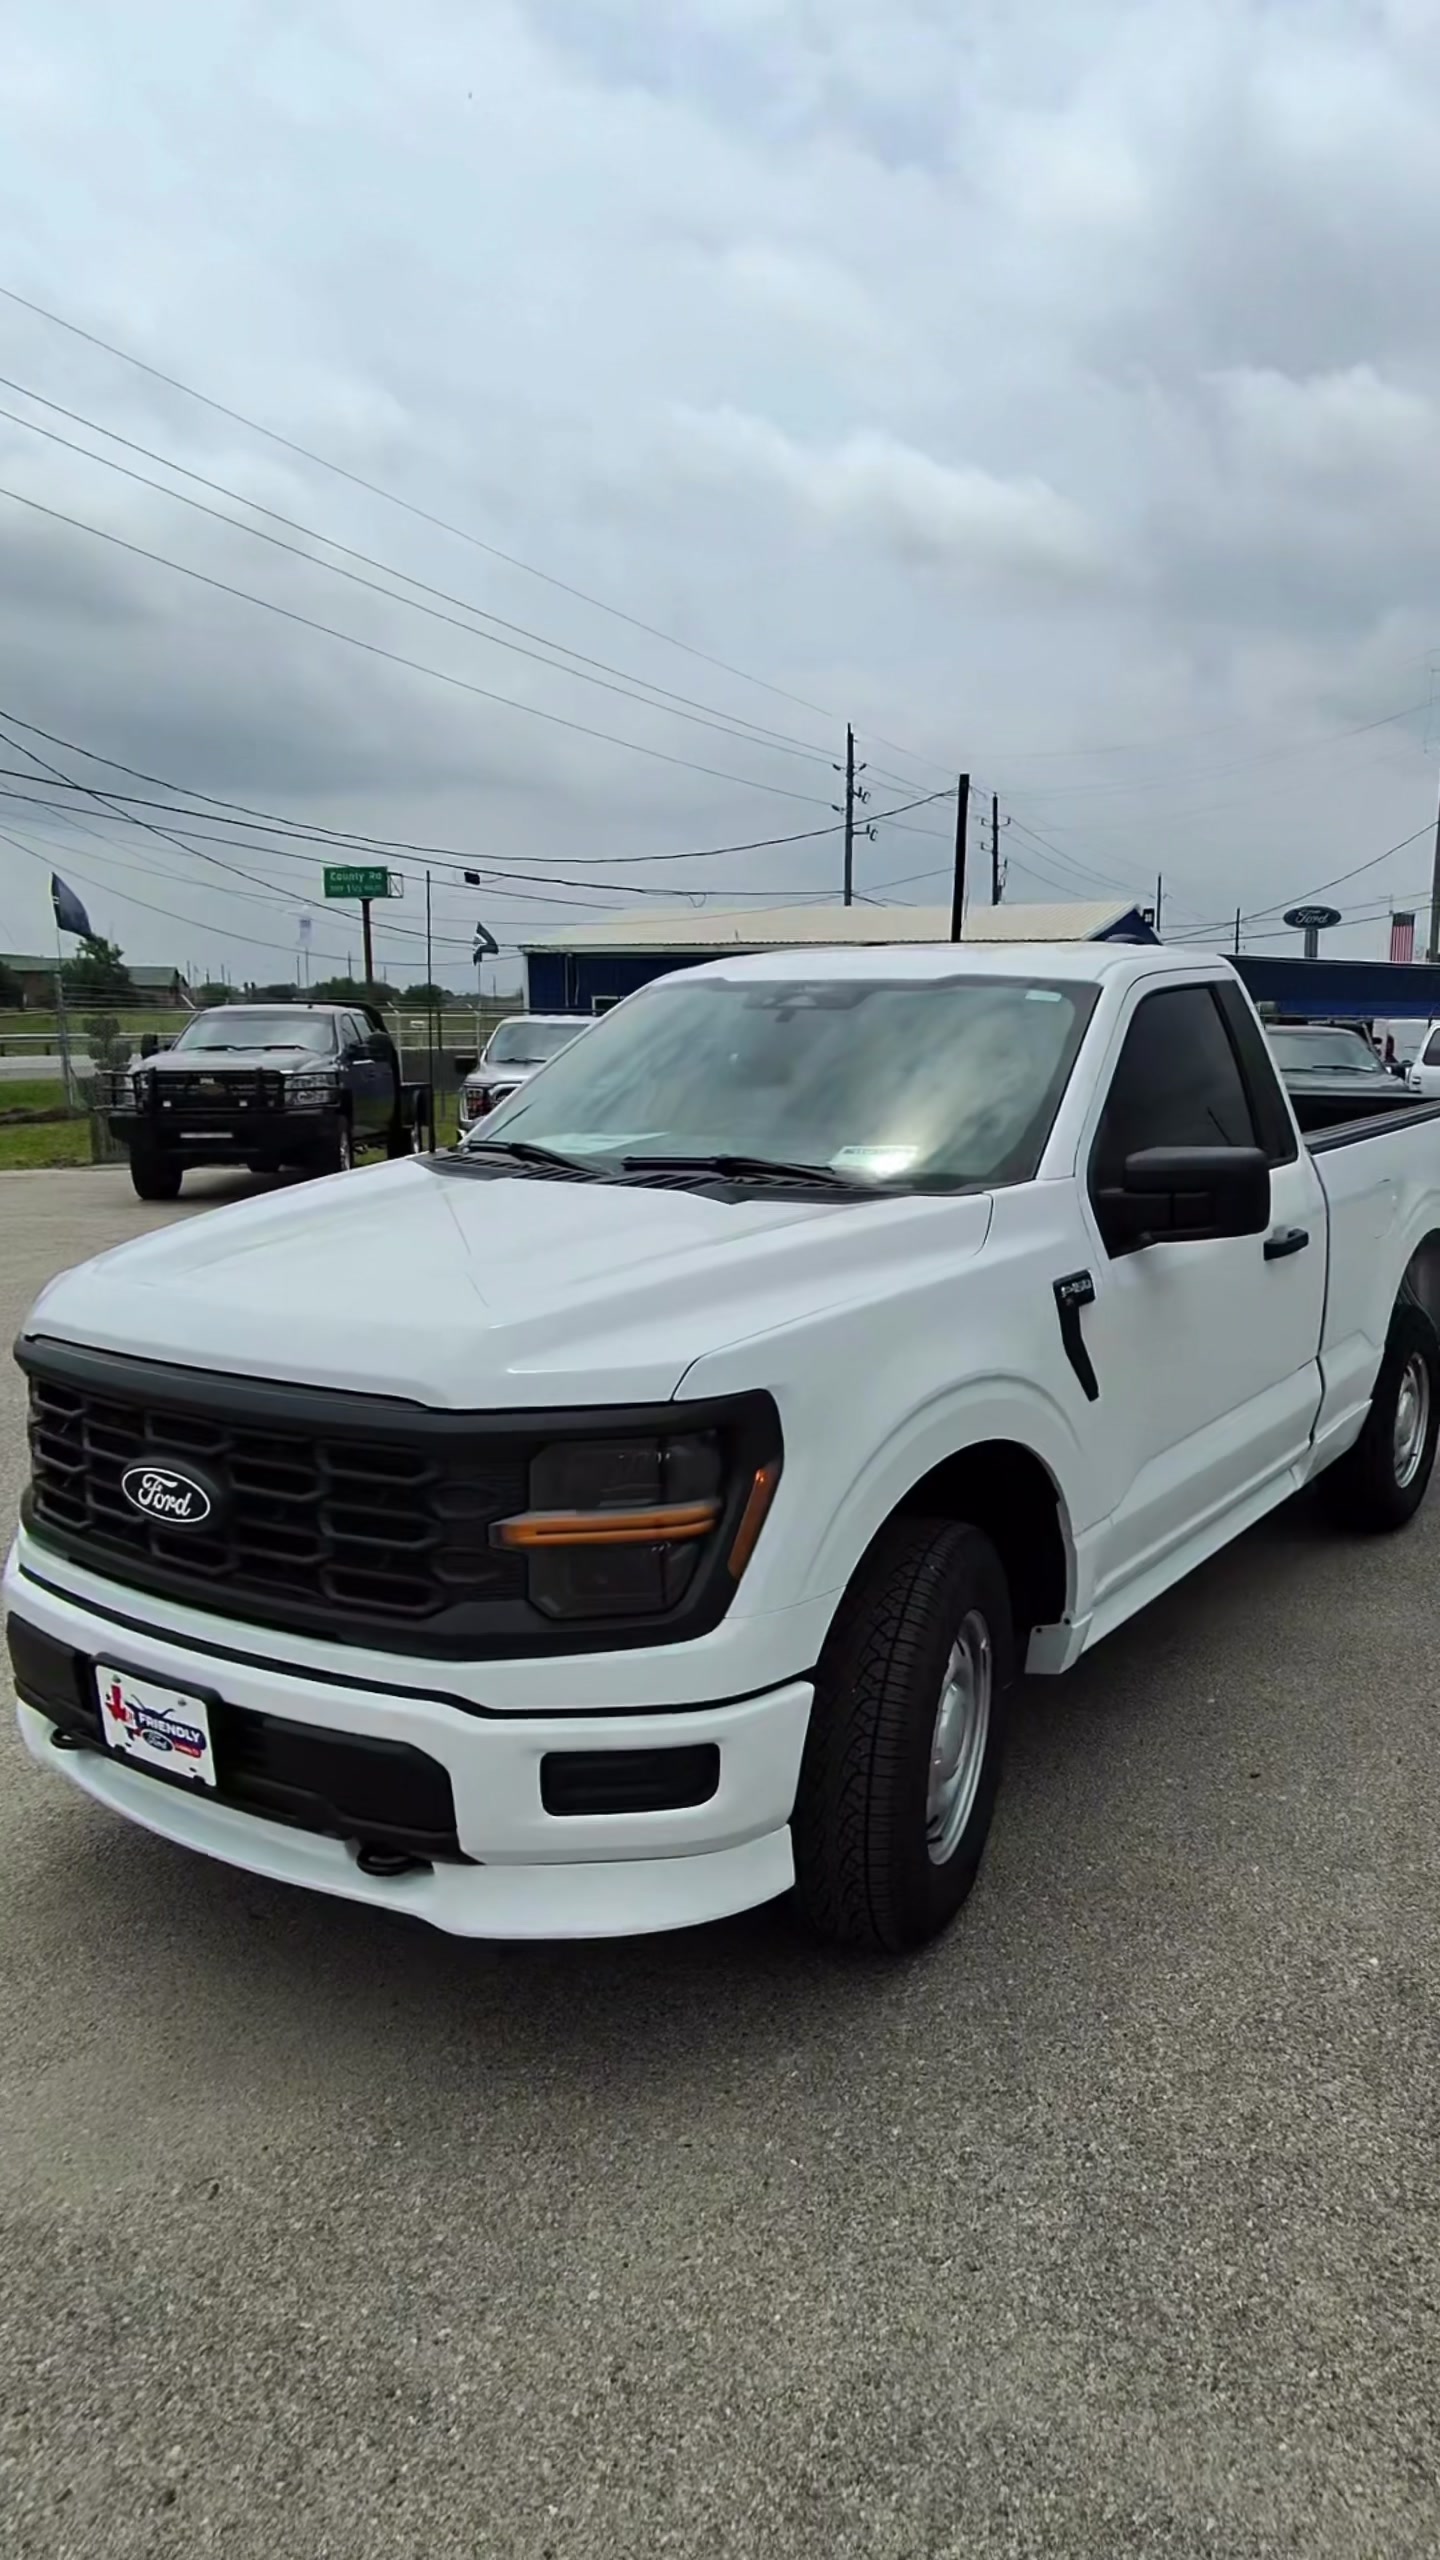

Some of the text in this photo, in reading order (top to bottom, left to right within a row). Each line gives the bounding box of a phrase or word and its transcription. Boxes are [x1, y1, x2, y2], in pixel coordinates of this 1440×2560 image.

[329, 871, 365, 883] County
[1295, 910, 1329, 923] Ford
[138, 1473, 192, 1516] Ford
[138, 1713, 200, 1742] FRIENDLY
